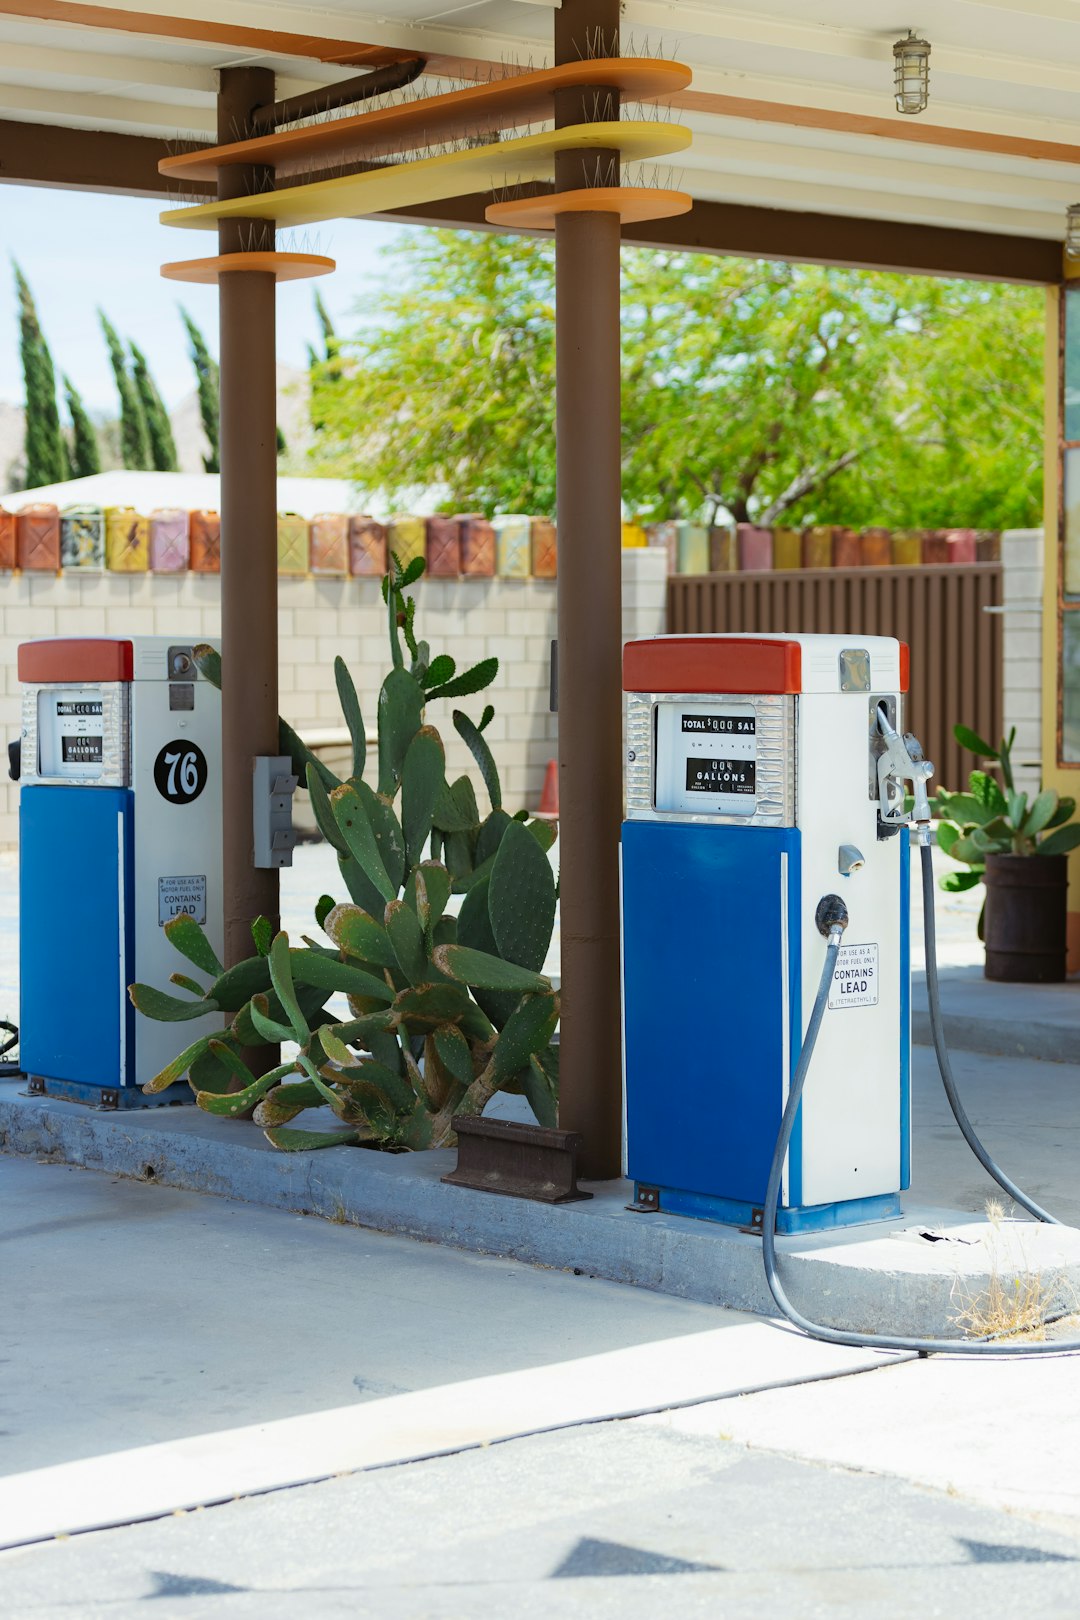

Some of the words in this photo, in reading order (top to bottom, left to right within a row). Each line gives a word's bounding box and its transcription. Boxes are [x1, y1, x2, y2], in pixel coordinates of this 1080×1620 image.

[683, 720, 706, 729] TOTAL
[68, 746, 99, 754] GALLONS
[164, 751, 199, 795] 76
[696, 771, 746, 782] GALLONS
[164, 894, 201, 904] CONTAINS
[170, 904, 196, 915] LEAD
[834, 967, 874, 980] CONTAINS
[840, 980, 868, 994] LEAD
